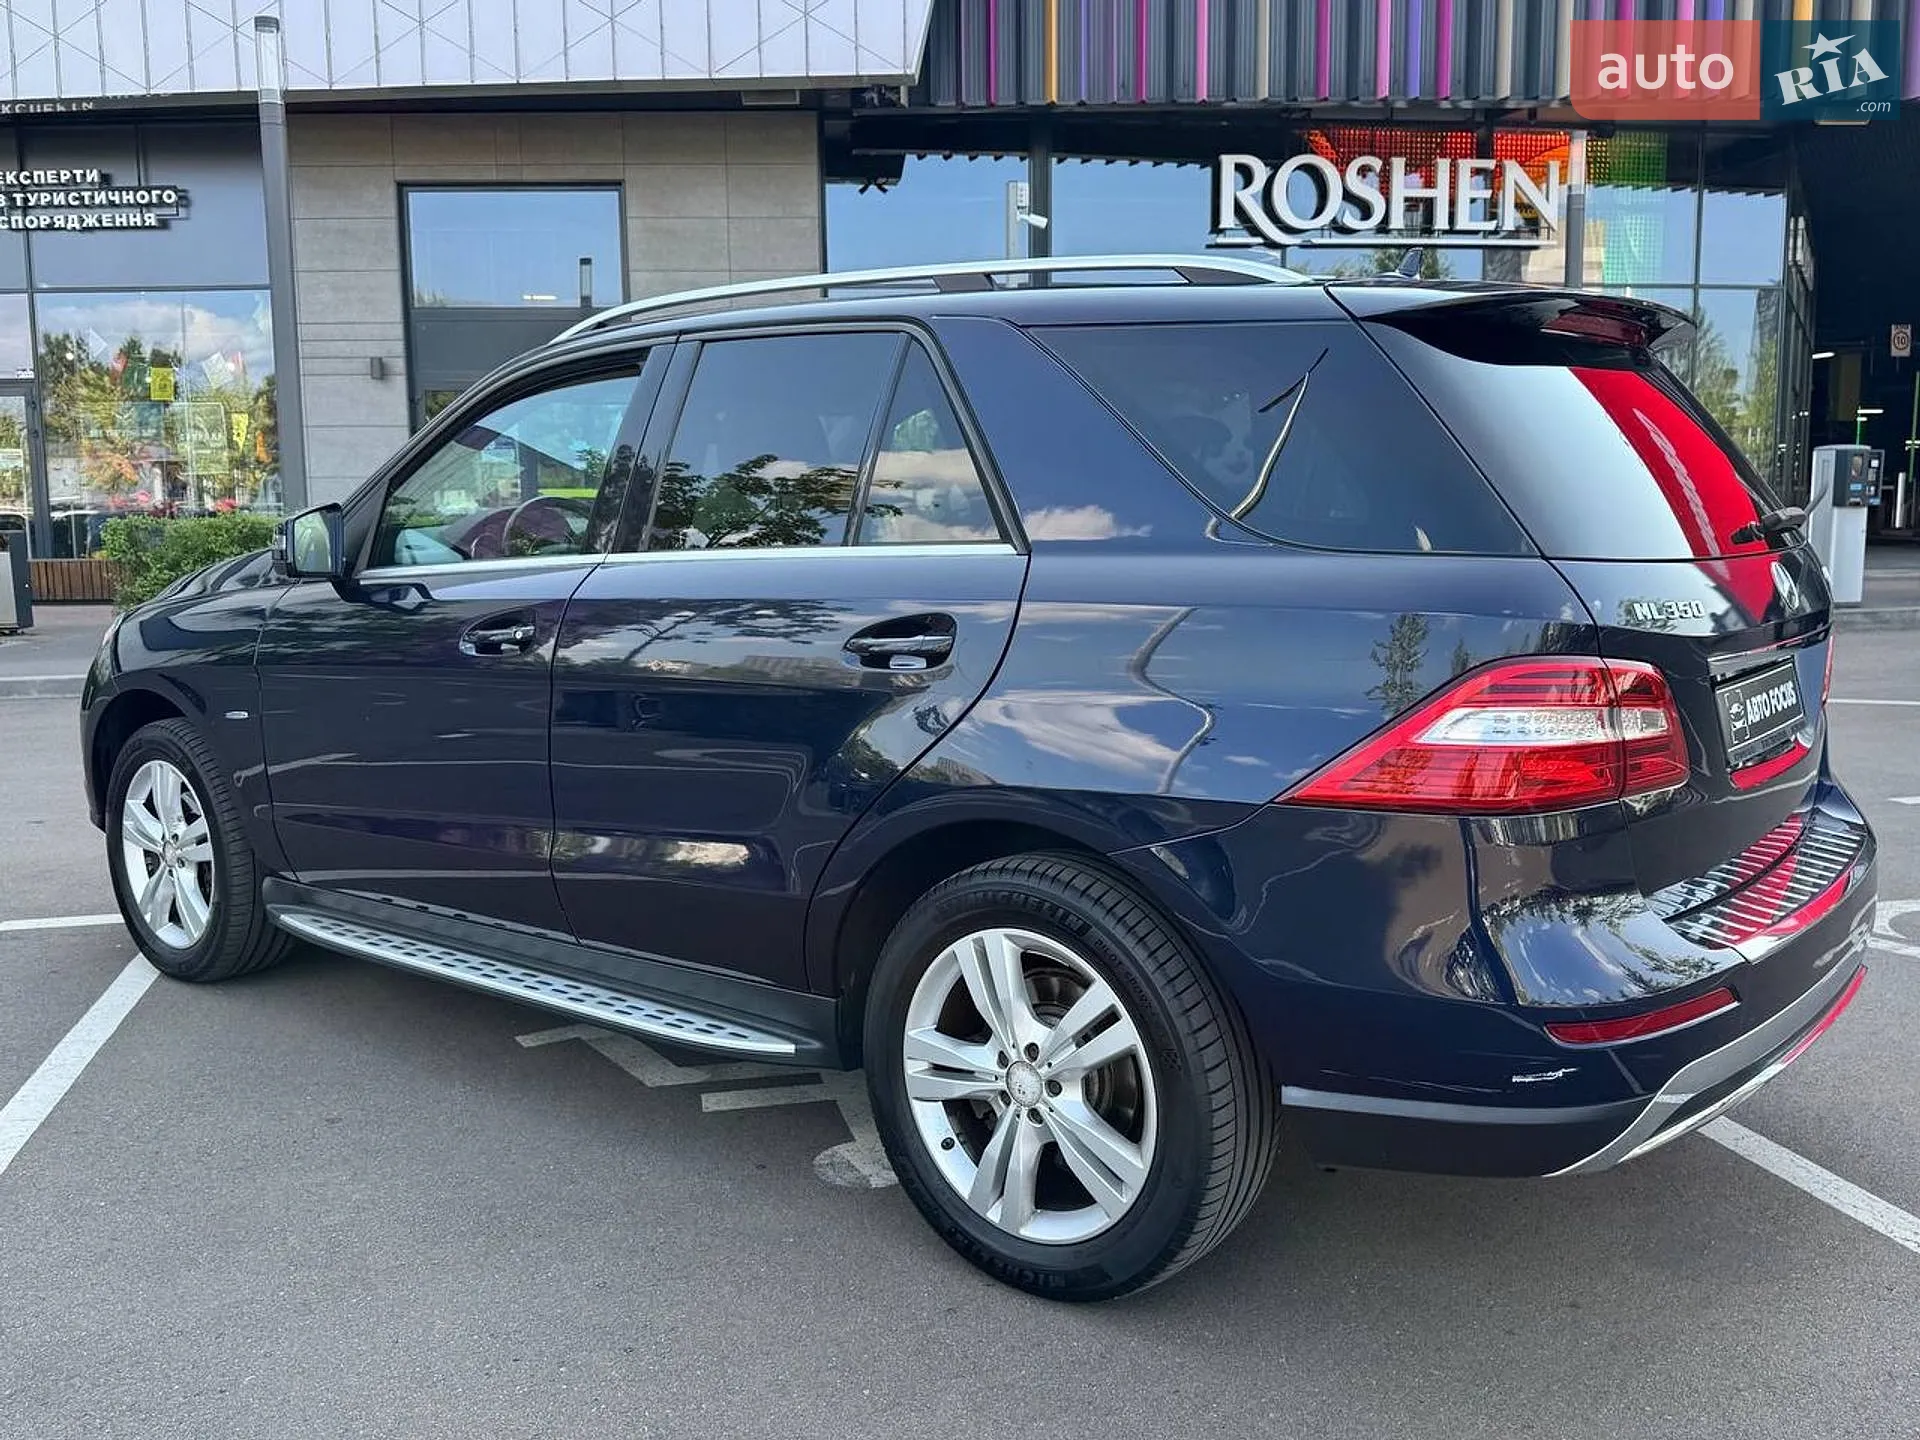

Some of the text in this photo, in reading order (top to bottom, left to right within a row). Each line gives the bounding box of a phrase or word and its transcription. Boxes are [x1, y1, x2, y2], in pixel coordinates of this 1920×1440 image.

[13, 190, 177, 207] ТУРИСТИЧНОГО
[1218, 153, 1561, 245] ROSHEN
[0, 212, 158, 231] СПОРЯДЖЕННЯ
